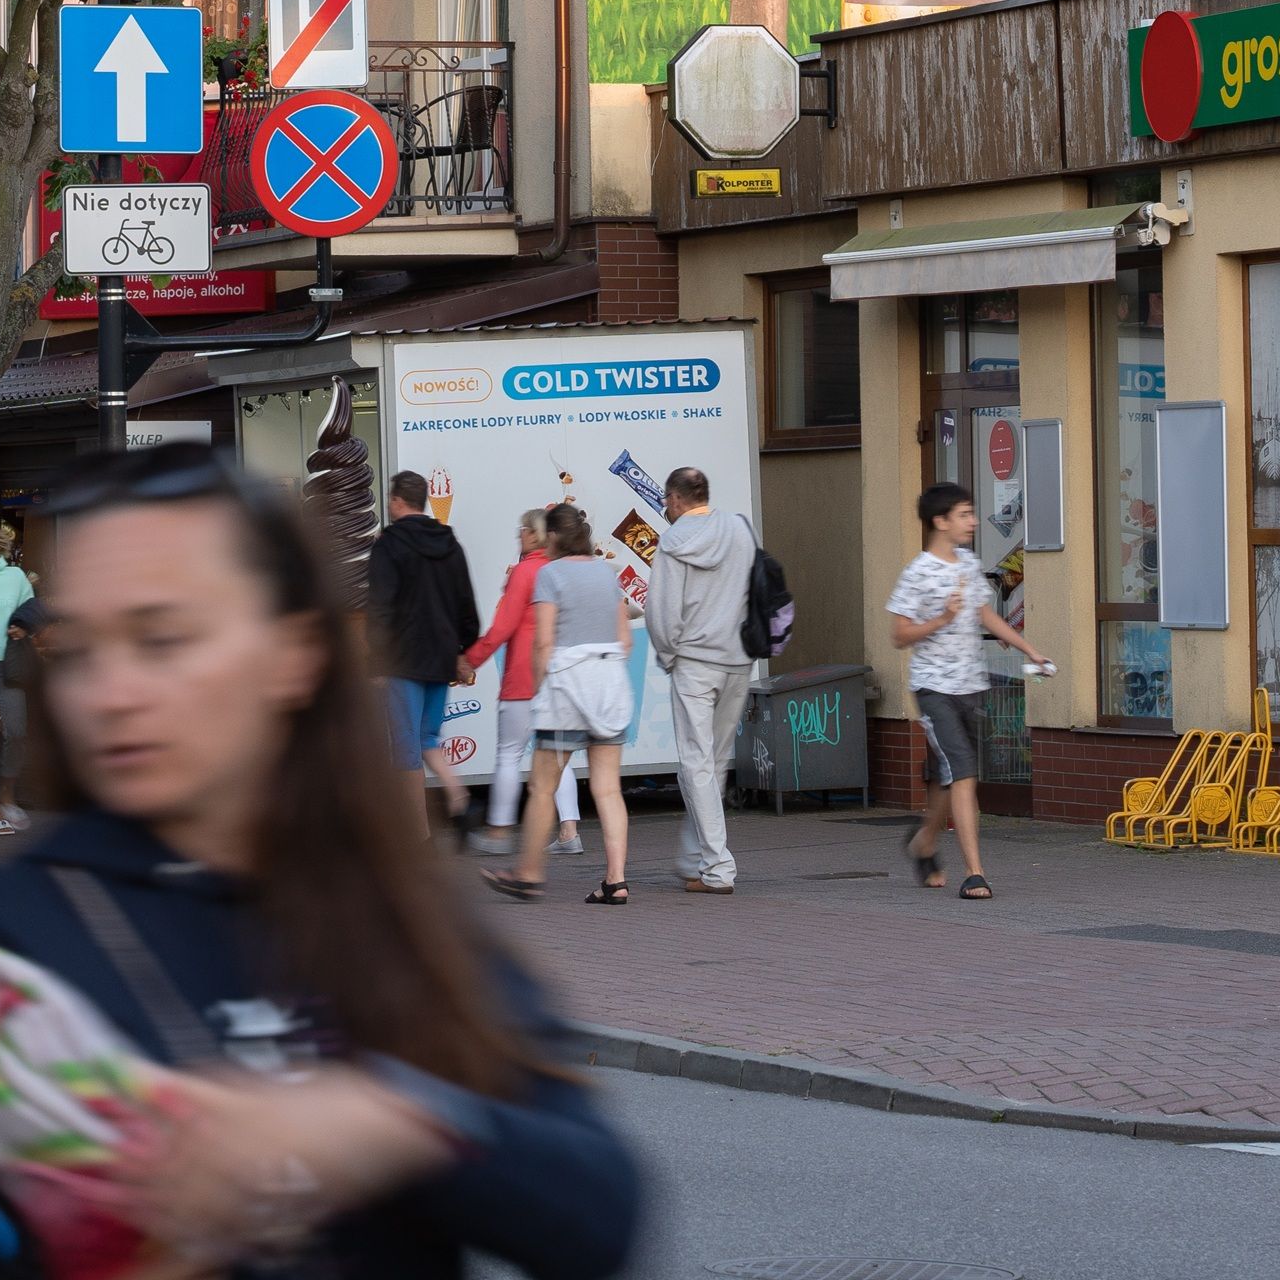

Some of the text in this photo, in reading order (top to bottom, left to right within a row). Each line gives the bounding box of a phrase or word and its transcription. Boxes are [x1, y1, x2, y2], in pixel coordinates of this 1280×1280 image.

[716, 177, 773, 192] KOLPORTER
[72, 191, 203, 216] Nie dotyczy
[152, 283, 246, 301] napoje, alkohol
[413, 378, 480, 394] NOWOŚĆ!
[513, 364, 710, 394] COLD TWISTER
[402, 406, 722, 433] ZAKRĘCONE LODY FLURRY LODY WŁOSKIE SHAKE
[442, 700, 481, 718] REO
